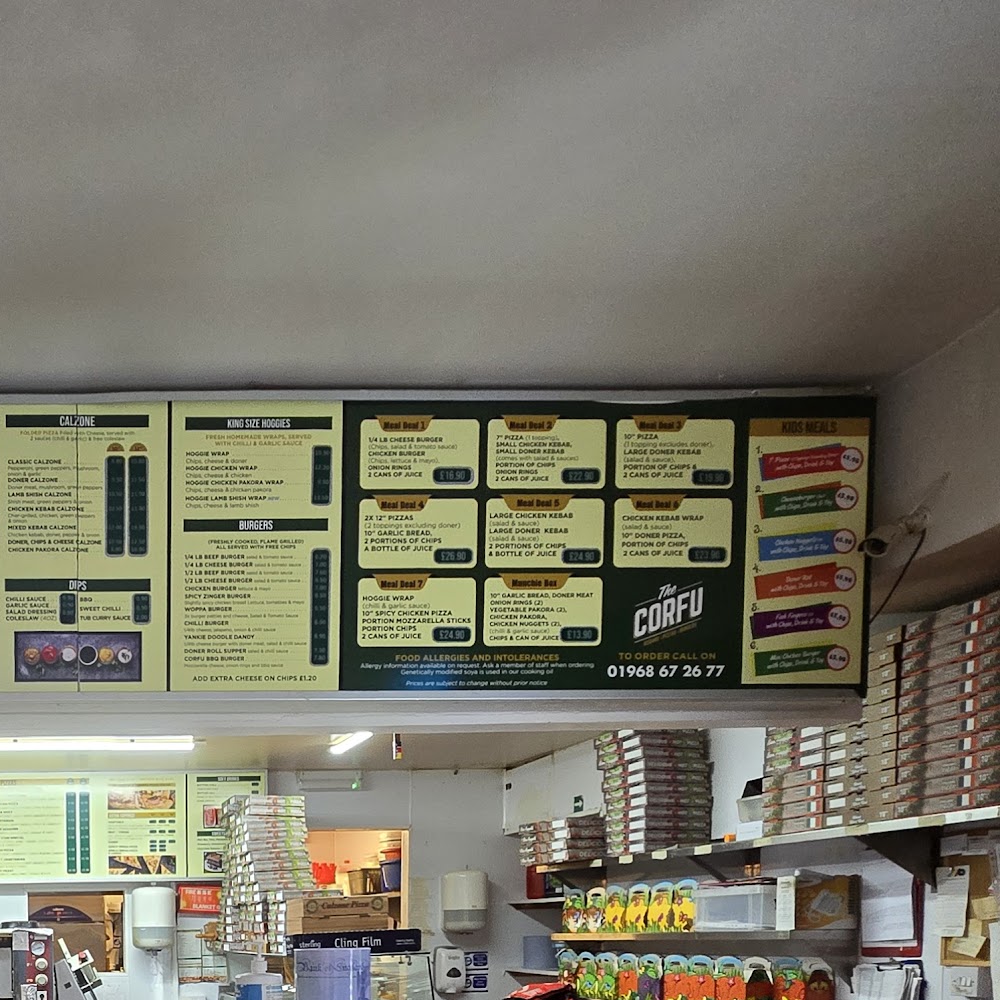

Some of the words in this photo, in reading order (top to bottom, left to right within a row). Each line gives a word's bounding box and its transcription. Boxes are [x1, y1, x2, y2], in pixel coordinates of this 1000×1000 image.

[59, 416, 95, 426] CALZONE
[227, 419, 243, 428] KING
[245, 419, 260, 428] SIZE
[262, 419, 290, 428] HOGGIES
[782, 422, 804, 433] KIDS
[806, 421, 837, 433] MEALS
[239, 520, 273, 530] BURGERS
[69, 580, 87, 590] DIPS
[400, 580, 416, 588] Deal
[658, 584, 677, 600] The
[633, 587, 703, 639] CORFU
[440, 630, 464, 639] £24.90
[607, 665, 654, 677] 01968
[659, 665, 678, 677] 67
[683, 665, 702, 677] 26
[706, 665, 725, 677] 77
[335, 938, 358, 947] Cling
[362, 937, 381, 946] Film
